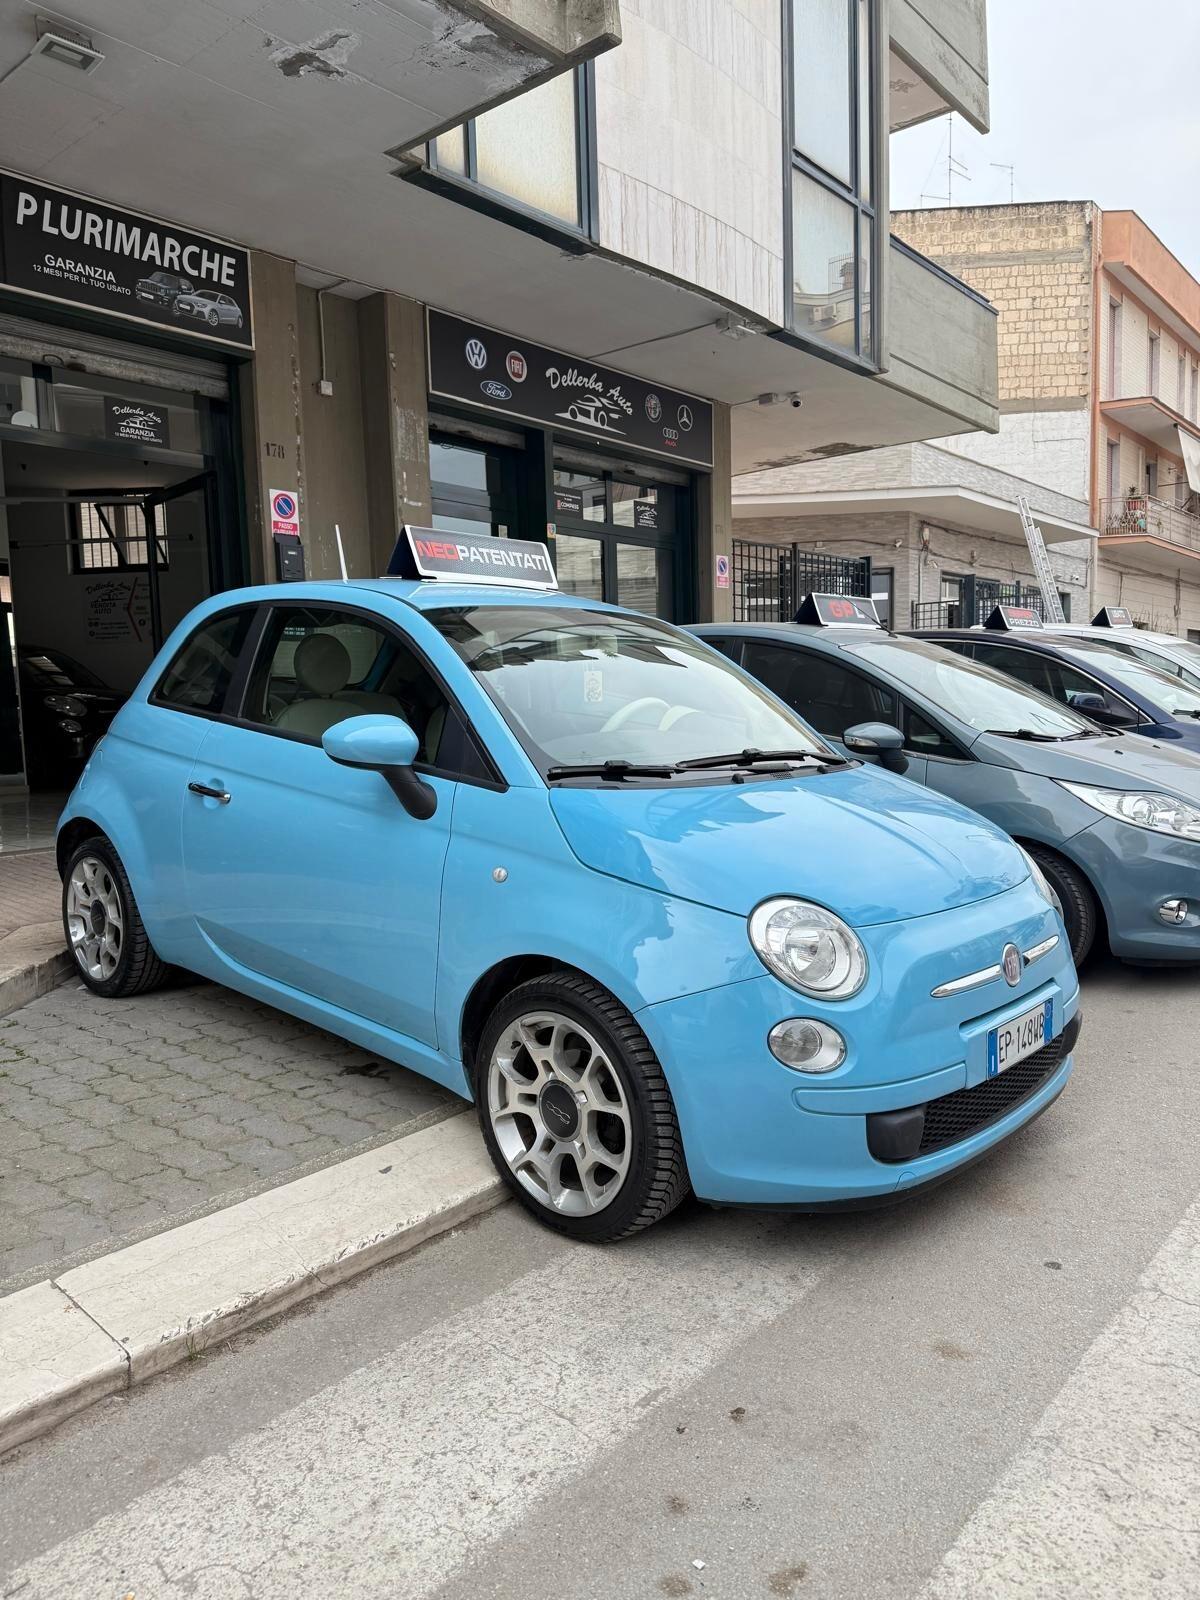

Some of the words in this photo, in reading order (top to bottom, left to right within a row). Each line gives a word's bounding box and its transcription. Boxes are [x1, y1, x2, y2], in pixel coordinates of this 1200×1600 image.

[16, 191, 236, 287] PLURIMARCHE
[32, 264, 42, 273] 12
[43, 266, 62, 278] MESI
[64, 272, 80, 282] PER
[89, 278, 106, 289] TUO
[106, 283, 131, 296] USATO
[44, 254, 117, 283] GARANZIA
[486, 382, 506, 398] Ford
[545, 367, 604, 393] Dellerba
[606, 386, 633, 416] Auto
[112, 405, 144, 416] Dellerba
[120, 426, 155, 438] GARANZIA
[264, 442, 285, 460] 178
[1008, 617, 1041, 628] PREZZO
[999, 1030, 1012, 1064] EP
[1016, 1012, 1045, 1054] 148WB
